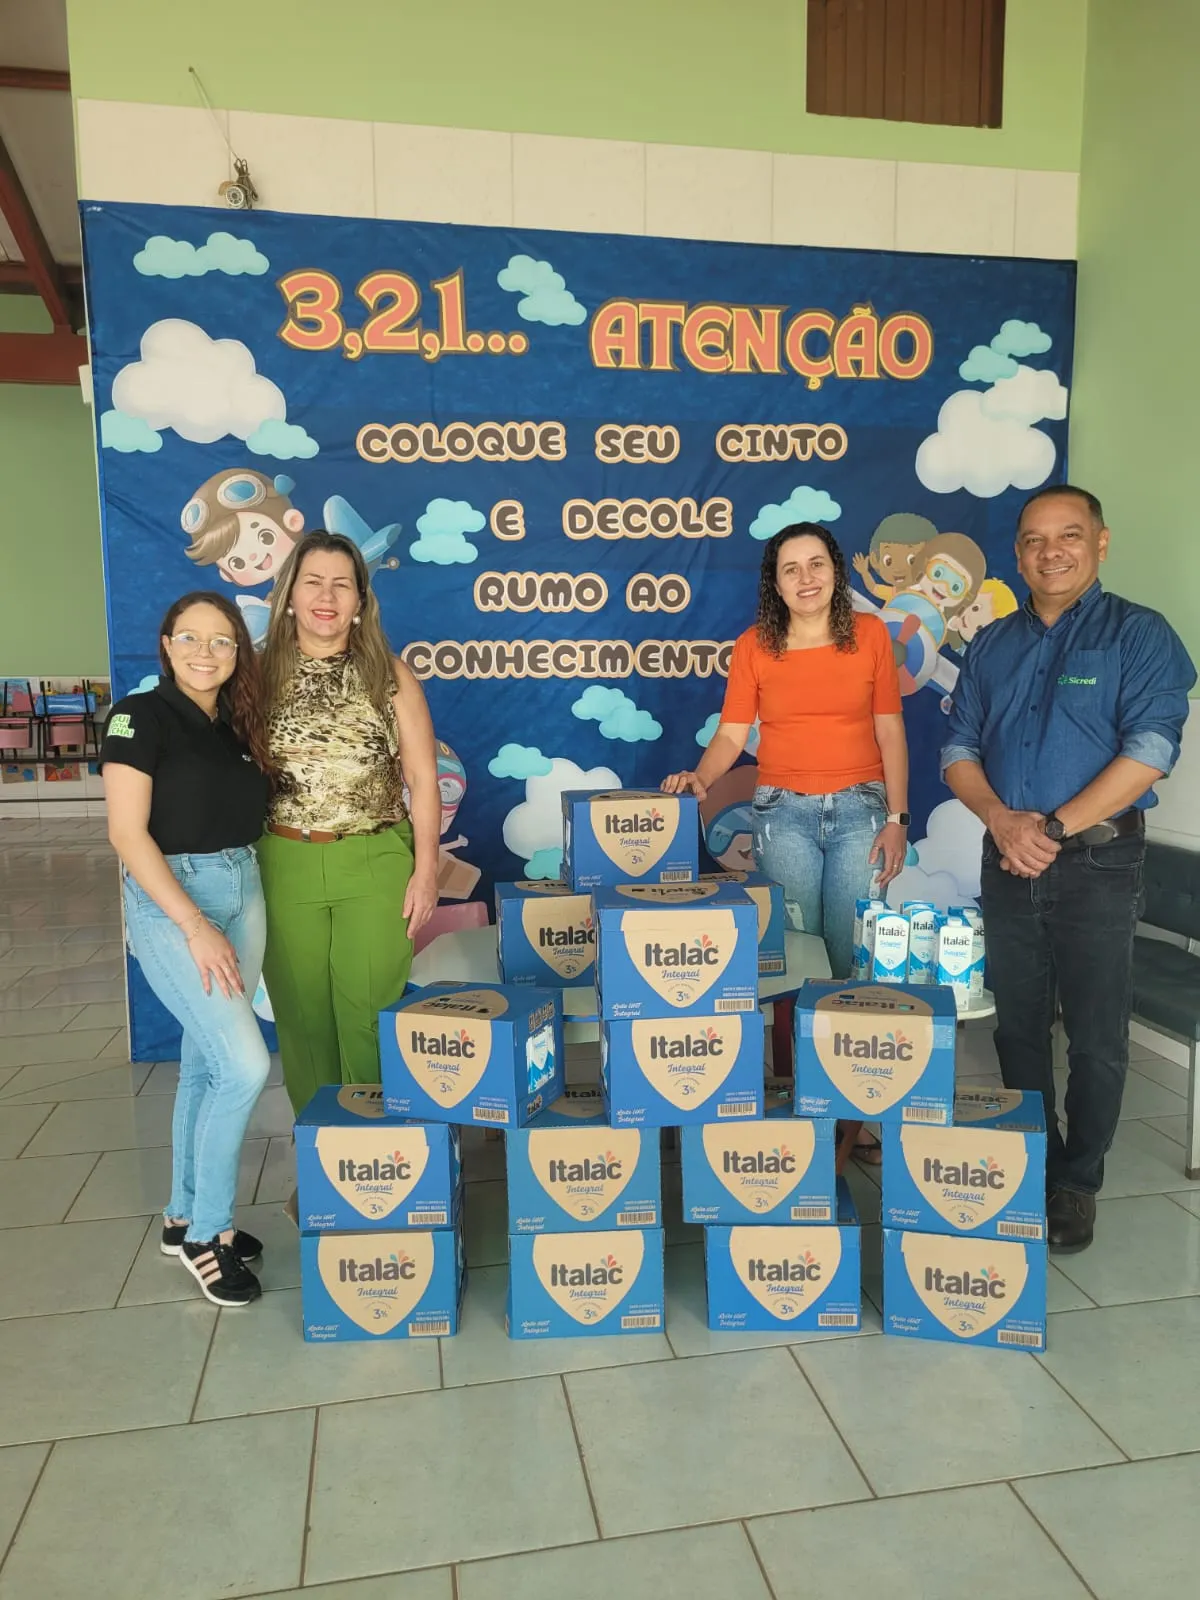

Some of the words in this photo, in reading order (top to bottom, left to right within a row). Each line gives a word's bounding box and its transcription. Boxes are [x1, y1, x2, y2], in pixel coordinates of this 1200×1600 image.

[590, 298, 935, 391] ATENÇÃO
[356, 421, 567, 464] COLOQUE
[595, 424, 680, 463] SEU
[715, 422, 848, 462] CINTO
[491, 499, 526, 541] E
[563, 497, 733, 541] DECOLE
[473, 571, 608, 612] RUMO
[627, 572, 691, 613] AO
[1069, 676, 1097, 685] Sicredi
[605, 814, 664, 834] Italac
[539, 926, 596, 947] Italac
[878, 926, 906, 936] Italac
[912, 921, 934, 931] Itala
[943, 936, 970, 946] Italac
[644, 942, 719, 967] Italac
[661, 969, 700, 980] Integral
[411, 1030, 476, 1059] Italac
[650, 1034, 724, 1060] Italac
[833, 1032, 914, 1062] Italac
[338, 1158, 412, 1182] Italac
[549, 1158, 623, 1183] Italac
[723, 1150, 796, 1174] Italac
[923, 1157, 1005, 1190] Italac
[338, 1258, 416, 1282] Italac
[550, 1262, 624, 1287] Italac
[748, 1258, 822, 1282] Italac
[924, 1266, 1006, 1300] Italac
